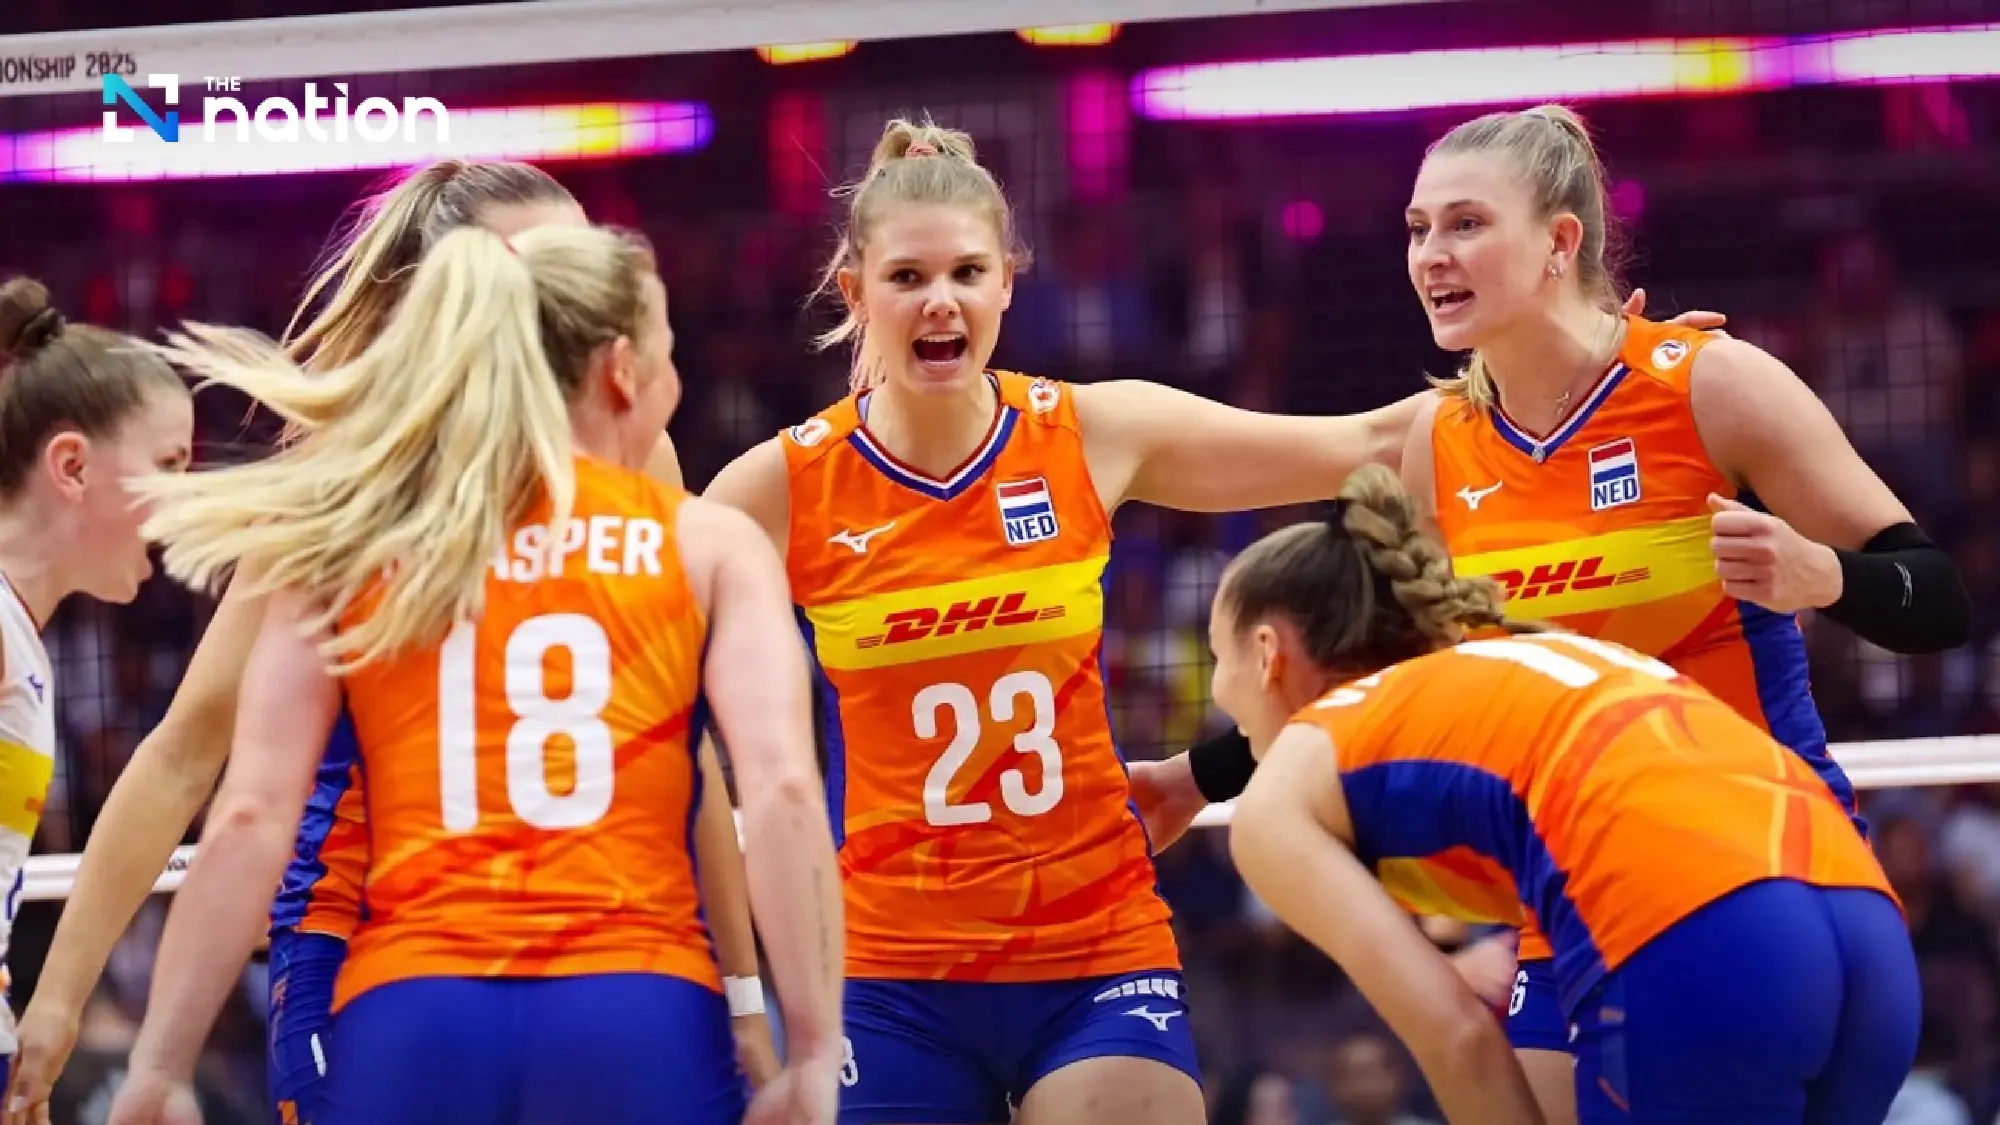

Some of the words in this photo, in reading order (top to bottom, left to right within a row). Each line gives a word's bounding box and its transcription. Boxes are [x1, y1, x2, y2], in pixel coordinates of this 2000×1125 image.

[1594, 478, 1638, 508] NED
[1006, 514, 1056, 543] NED
[1490, 556, 1617, 601] DHL
[882, 591, 1038, 645] DHL
[439, 612, 616, 833] 18
[911, 670, 1064, 827] 23
